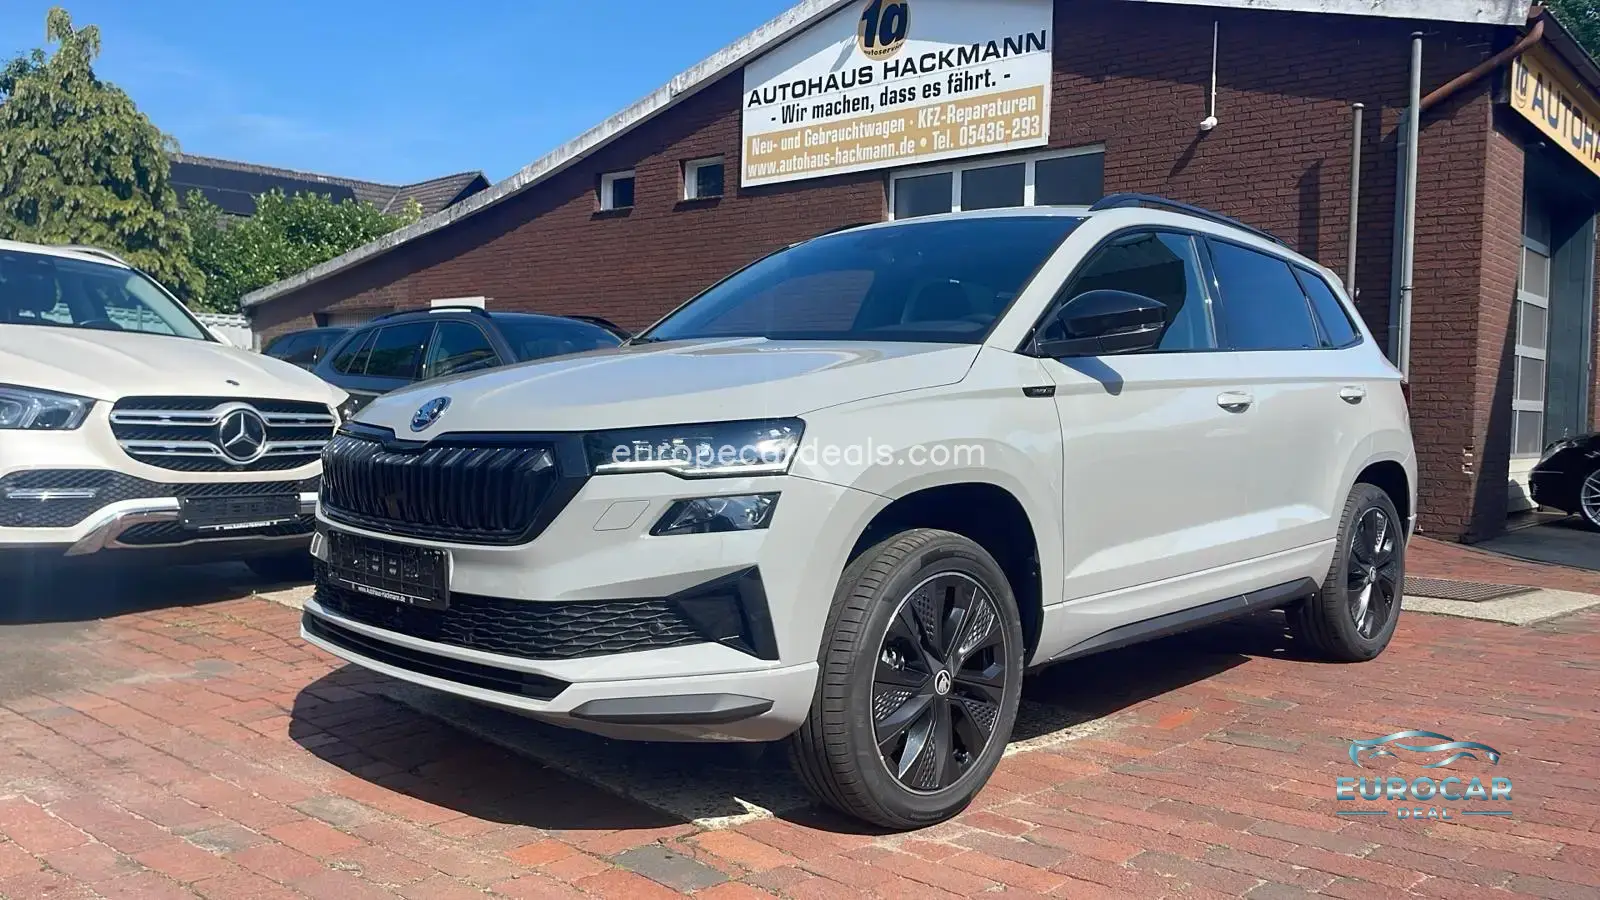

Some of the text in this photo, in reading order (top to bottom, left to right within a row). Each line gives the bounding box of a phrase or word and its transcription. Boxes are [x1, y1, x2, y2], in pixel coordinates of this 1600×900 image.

[747, 30, 1047, 108] AUTOHAUS HACKMANN
[781, 104, 808, 125] Wir
[812, 94, 875, 120] machen,
[880, 84, 916, 107] dass
[922, 80, 941, 98] es
[947, 69, 996, 95] fährt.
[747, 114, 1041, 178] www.autohaus-hackmann.de Tel. 05436-293
[751, 94, 1037, 157] Neu- und Gebrauchtwagen KFZ-Reparaturen
